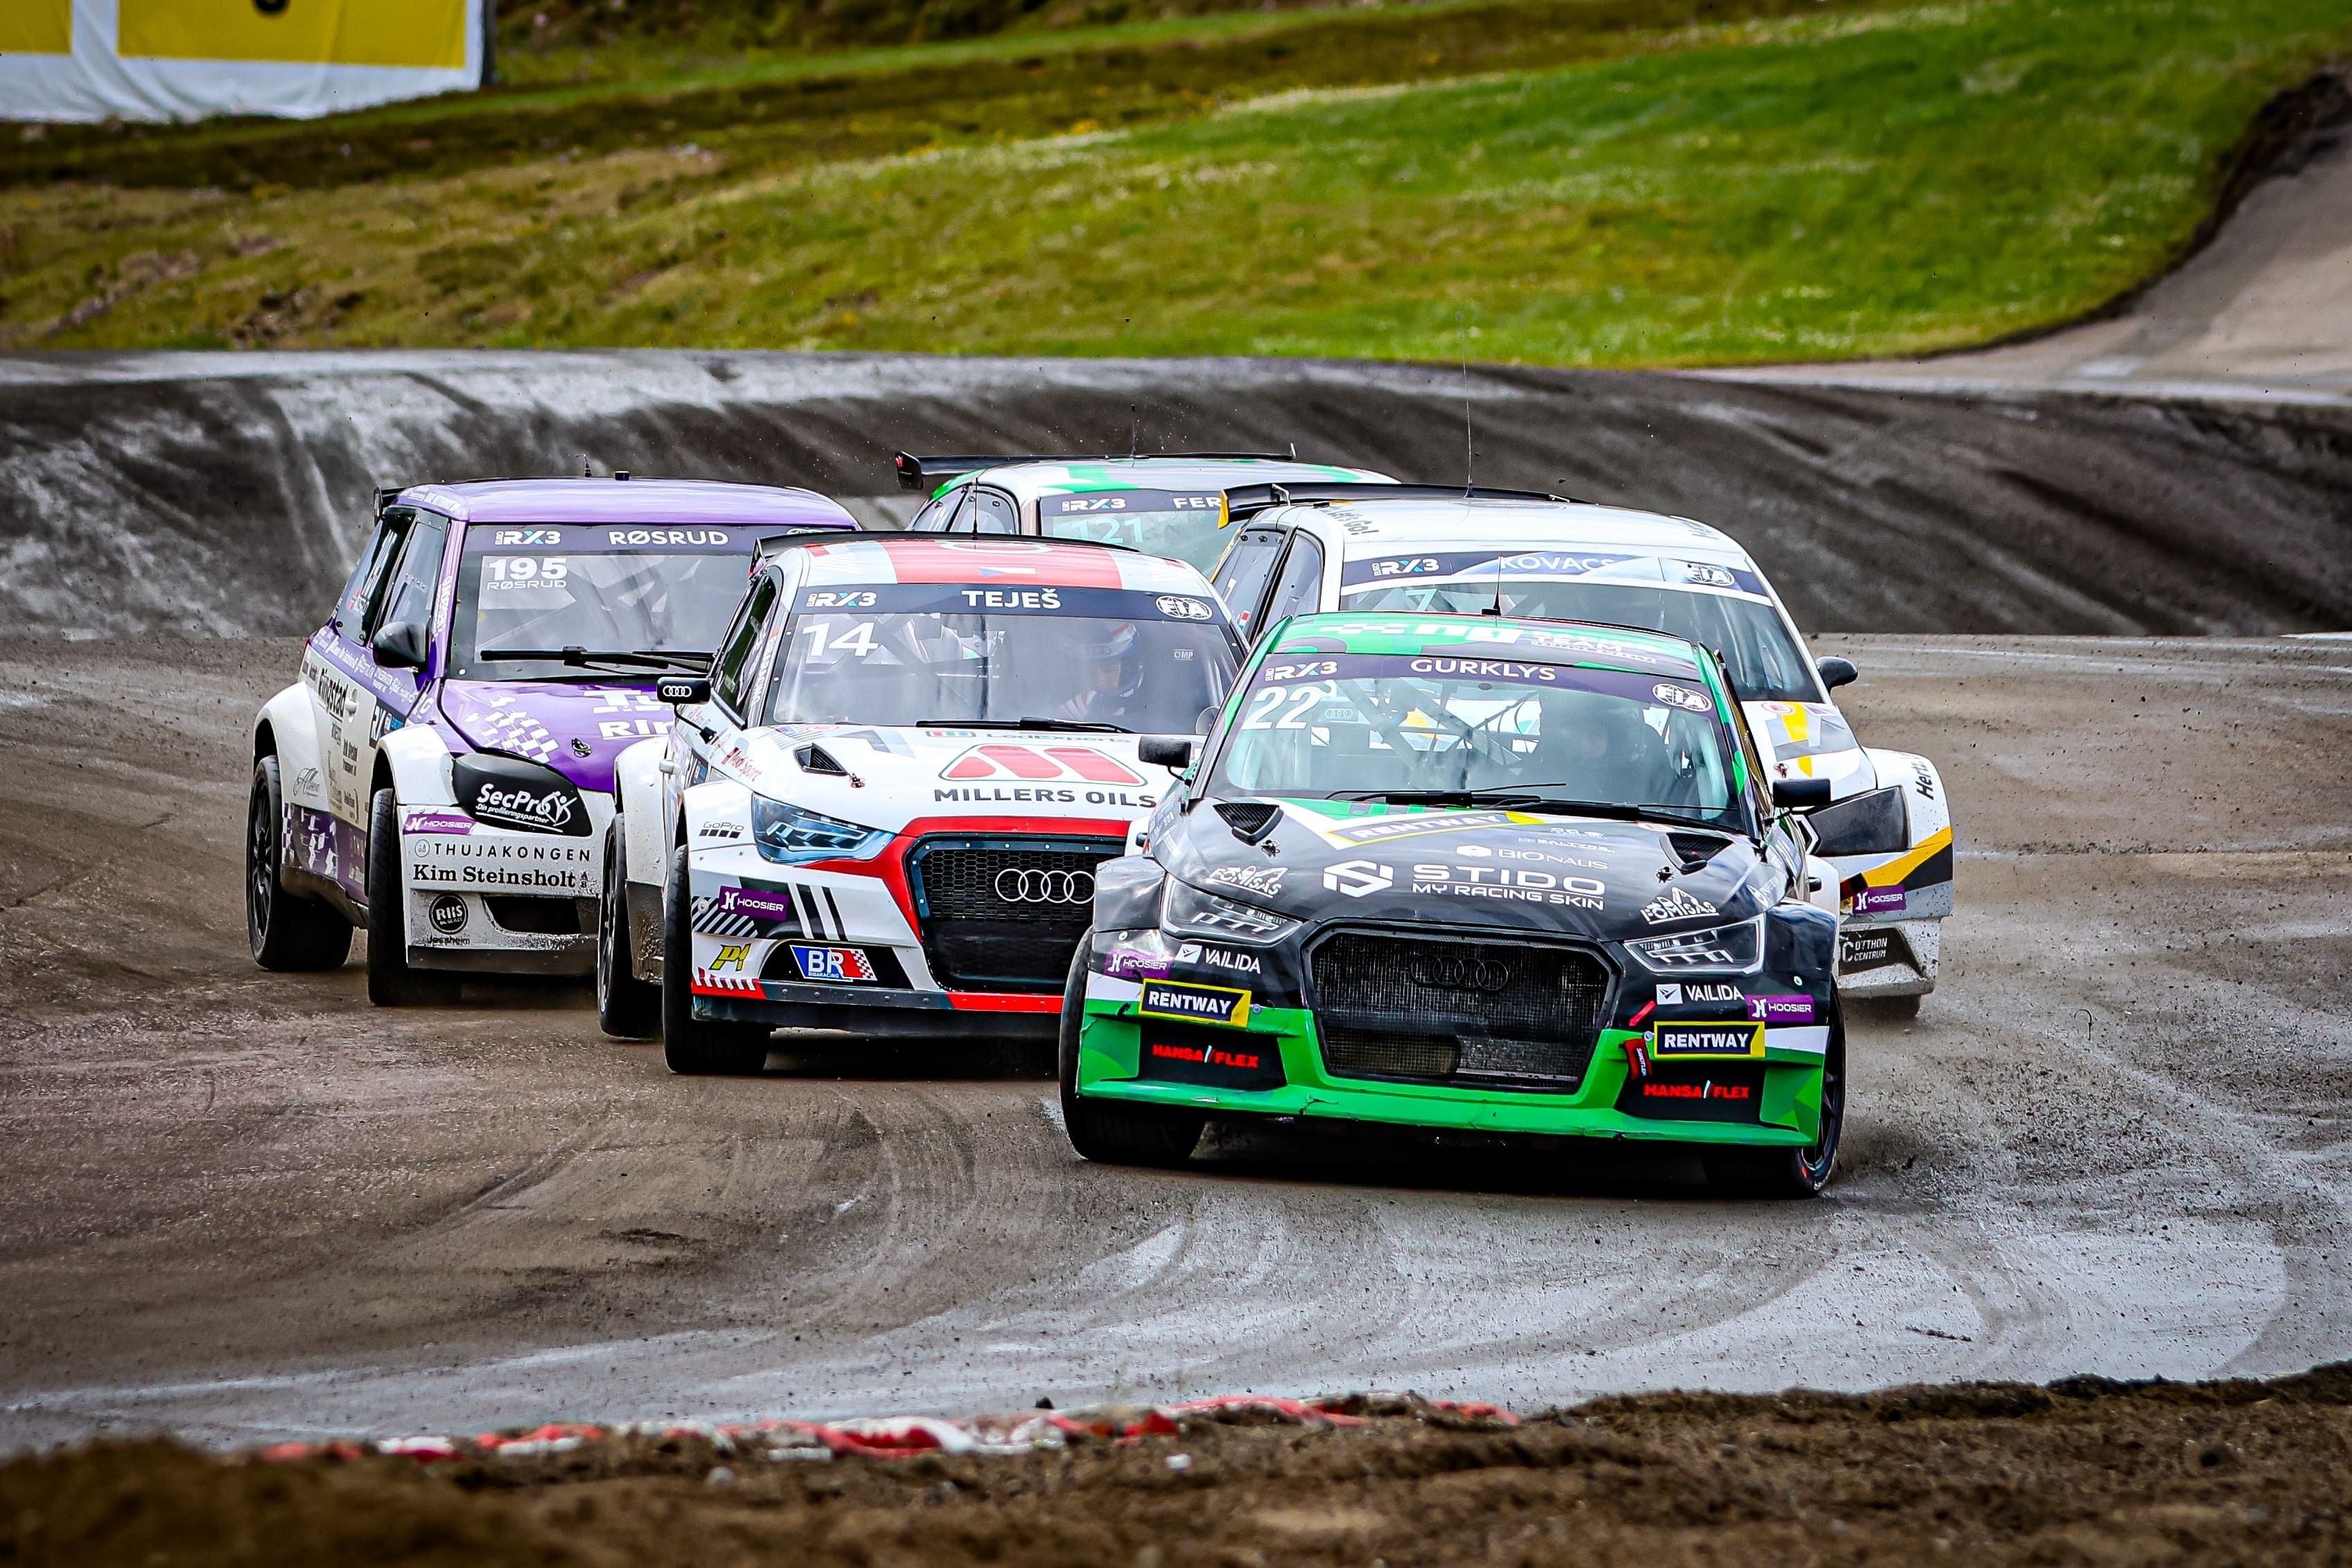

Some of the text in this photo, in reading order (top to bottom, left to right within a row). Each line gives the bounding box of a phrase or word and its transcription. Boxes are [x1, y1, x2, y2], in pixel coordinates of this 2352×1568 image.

[1070, 498, 1126, 511] RX3
[504, 530, 561, 545] RX3
[608, 530, 728, 545] RØSRUD
[489, 557, 568, 581] 195
[1380, 558, 1439, 575] RX3
[1500, 556, 1616, 572] KOVACS
[487, 580, 567, 590] RØSRUD
[814, 592, 877, 606] RX3
[961, 588, 1061, 609] TEJEŠ
[1157, 597, 1211, 619] FIA
[802, 622, 879, 656] 14
[1532, 635, 1622, 653] TEAM
[1174, 651, 1193, 660] OMP
[1274, 661, 1337, 680] RX3
[1411, 659, 1556, 681] GURKLYS
[1655, 685, 1709, 710] FIA
[1246, 686, 1323, 730] 22
[477, 783, 551, 815] SecPro
[934, 789, 1156, 809] MILLERS OILS
[423, 820, 473, 829] HOOSIER
[703, 821, 744, 831] GoPro
[1351, 815, 1502, 840] RENTWAY
[435, 843, 590, 862] THUJAKONGEN
[1498, 849, 1608, 870] BIONALIS
[413, 864, 457, 882] Kim
[463, 866, 576, 888] Steinsholt
[1209, 867, 1282, 895] FOMISAS
[1412, 863, 1607, 895] STIDO
[737, 898, 784, 912] HOOSIER
[1412, 883, 1604, 911] MY RACING SKIN
[1868, 893, 1903, 904] HOOSIER
[1640, 901, 1717, 922] FOMISAS
[1855, 937, 1888, 951] OTTHON
[809, 950, 844, 975] BR
[1123, 958, 1168, 970] HOOSIER
[1205, 948, 1261, 974] VAILIDA
[1854, 949, 1886, 962] CENTRUM
[1685, 984, 1746, 1001] VAILIDA
[1149, 991, 1231, 1014] RENTWAY
[1769, 1003, 1812, 1013] HOOSIER
[1664, 1033, 1748, 1048] RENTWAY
